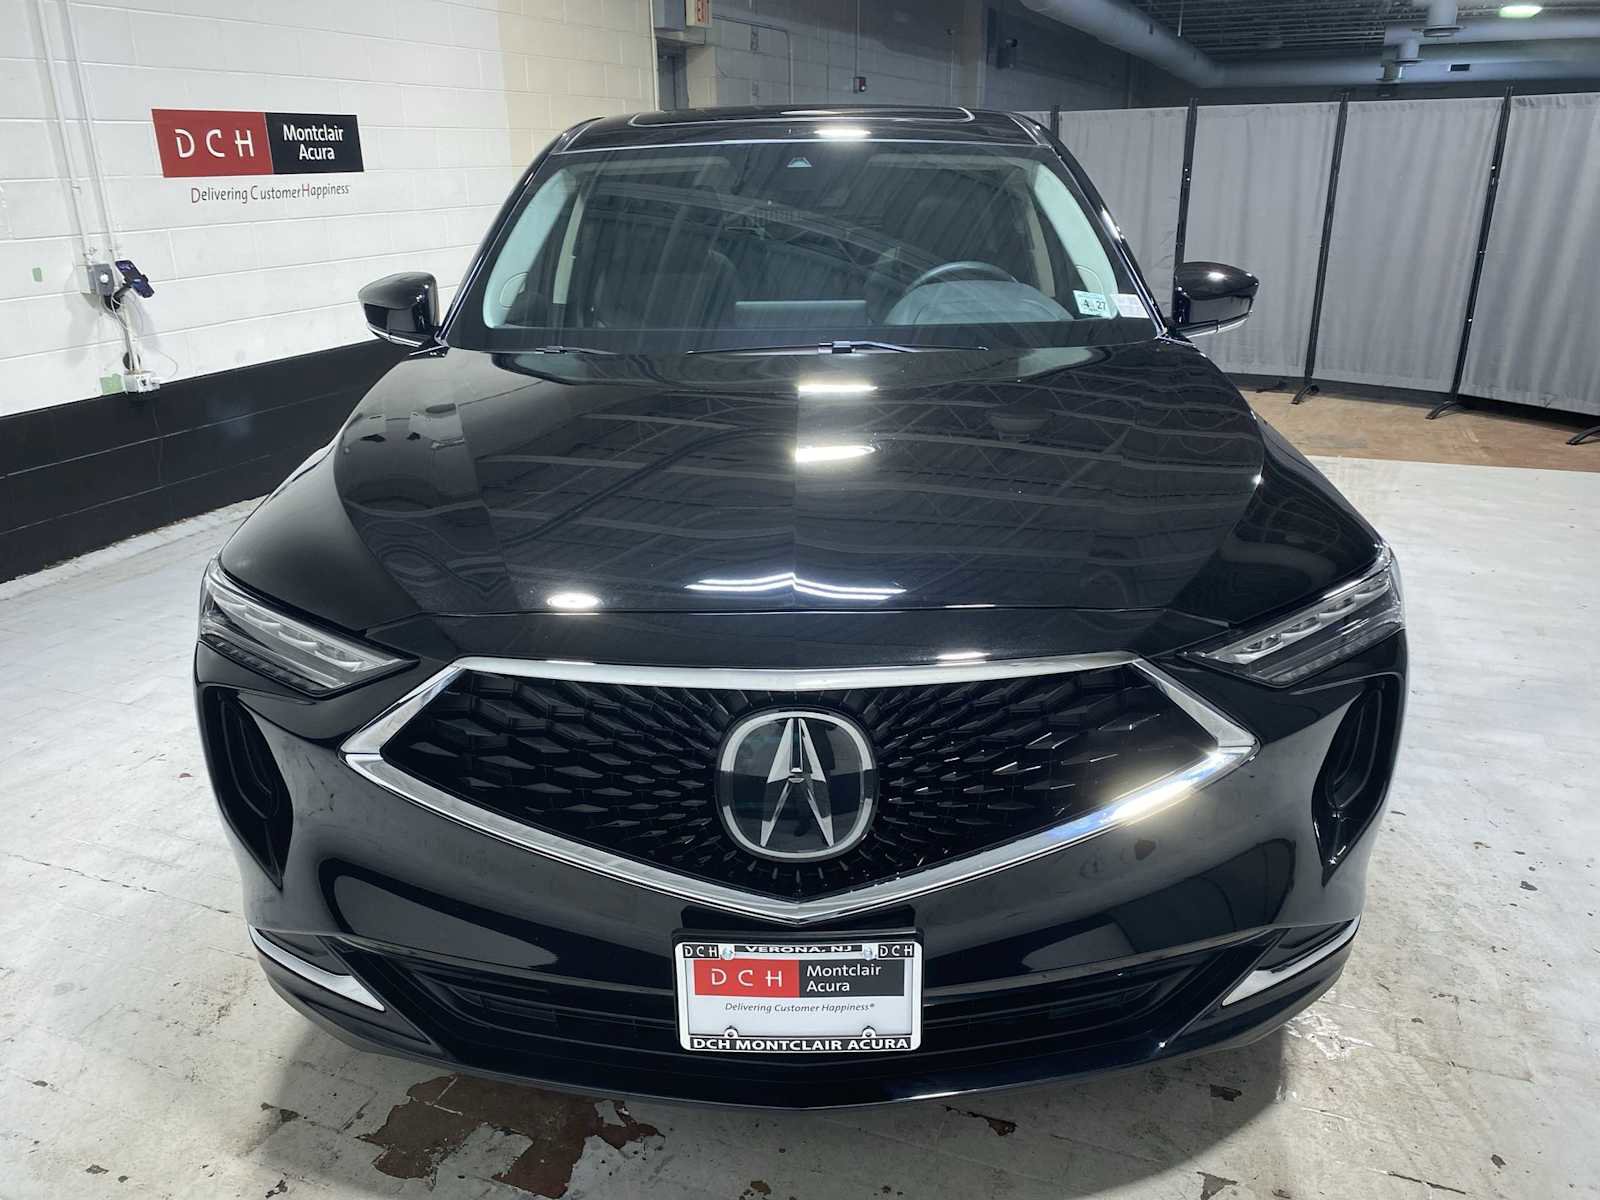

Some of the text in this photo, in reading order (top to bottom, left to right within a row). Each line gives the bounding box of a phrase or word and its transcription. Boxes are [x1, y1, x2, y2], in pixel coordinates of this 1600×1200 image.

[282, 123, 344, 142] Montclair
[174, 128, 255, 158] DCH
[298, 145, 336, 161] Acura
[191, 186, 248, 204] Delivering
[684, 945, 718, 958] DCH
[831, 945, 853, 953] NJ
[879, 944, 913, 957] DCH
[806, 964, 882, 977] Montclair
[711, 968, 783, 987] DCH
[806, 980, 851, 992] Acura
[725, 1002, 772, 1014] Delivering
[774, 1003, 819, 1013] Customer
[693, 1037, 909, 1051] DCH MONTCLAIR ACURA
